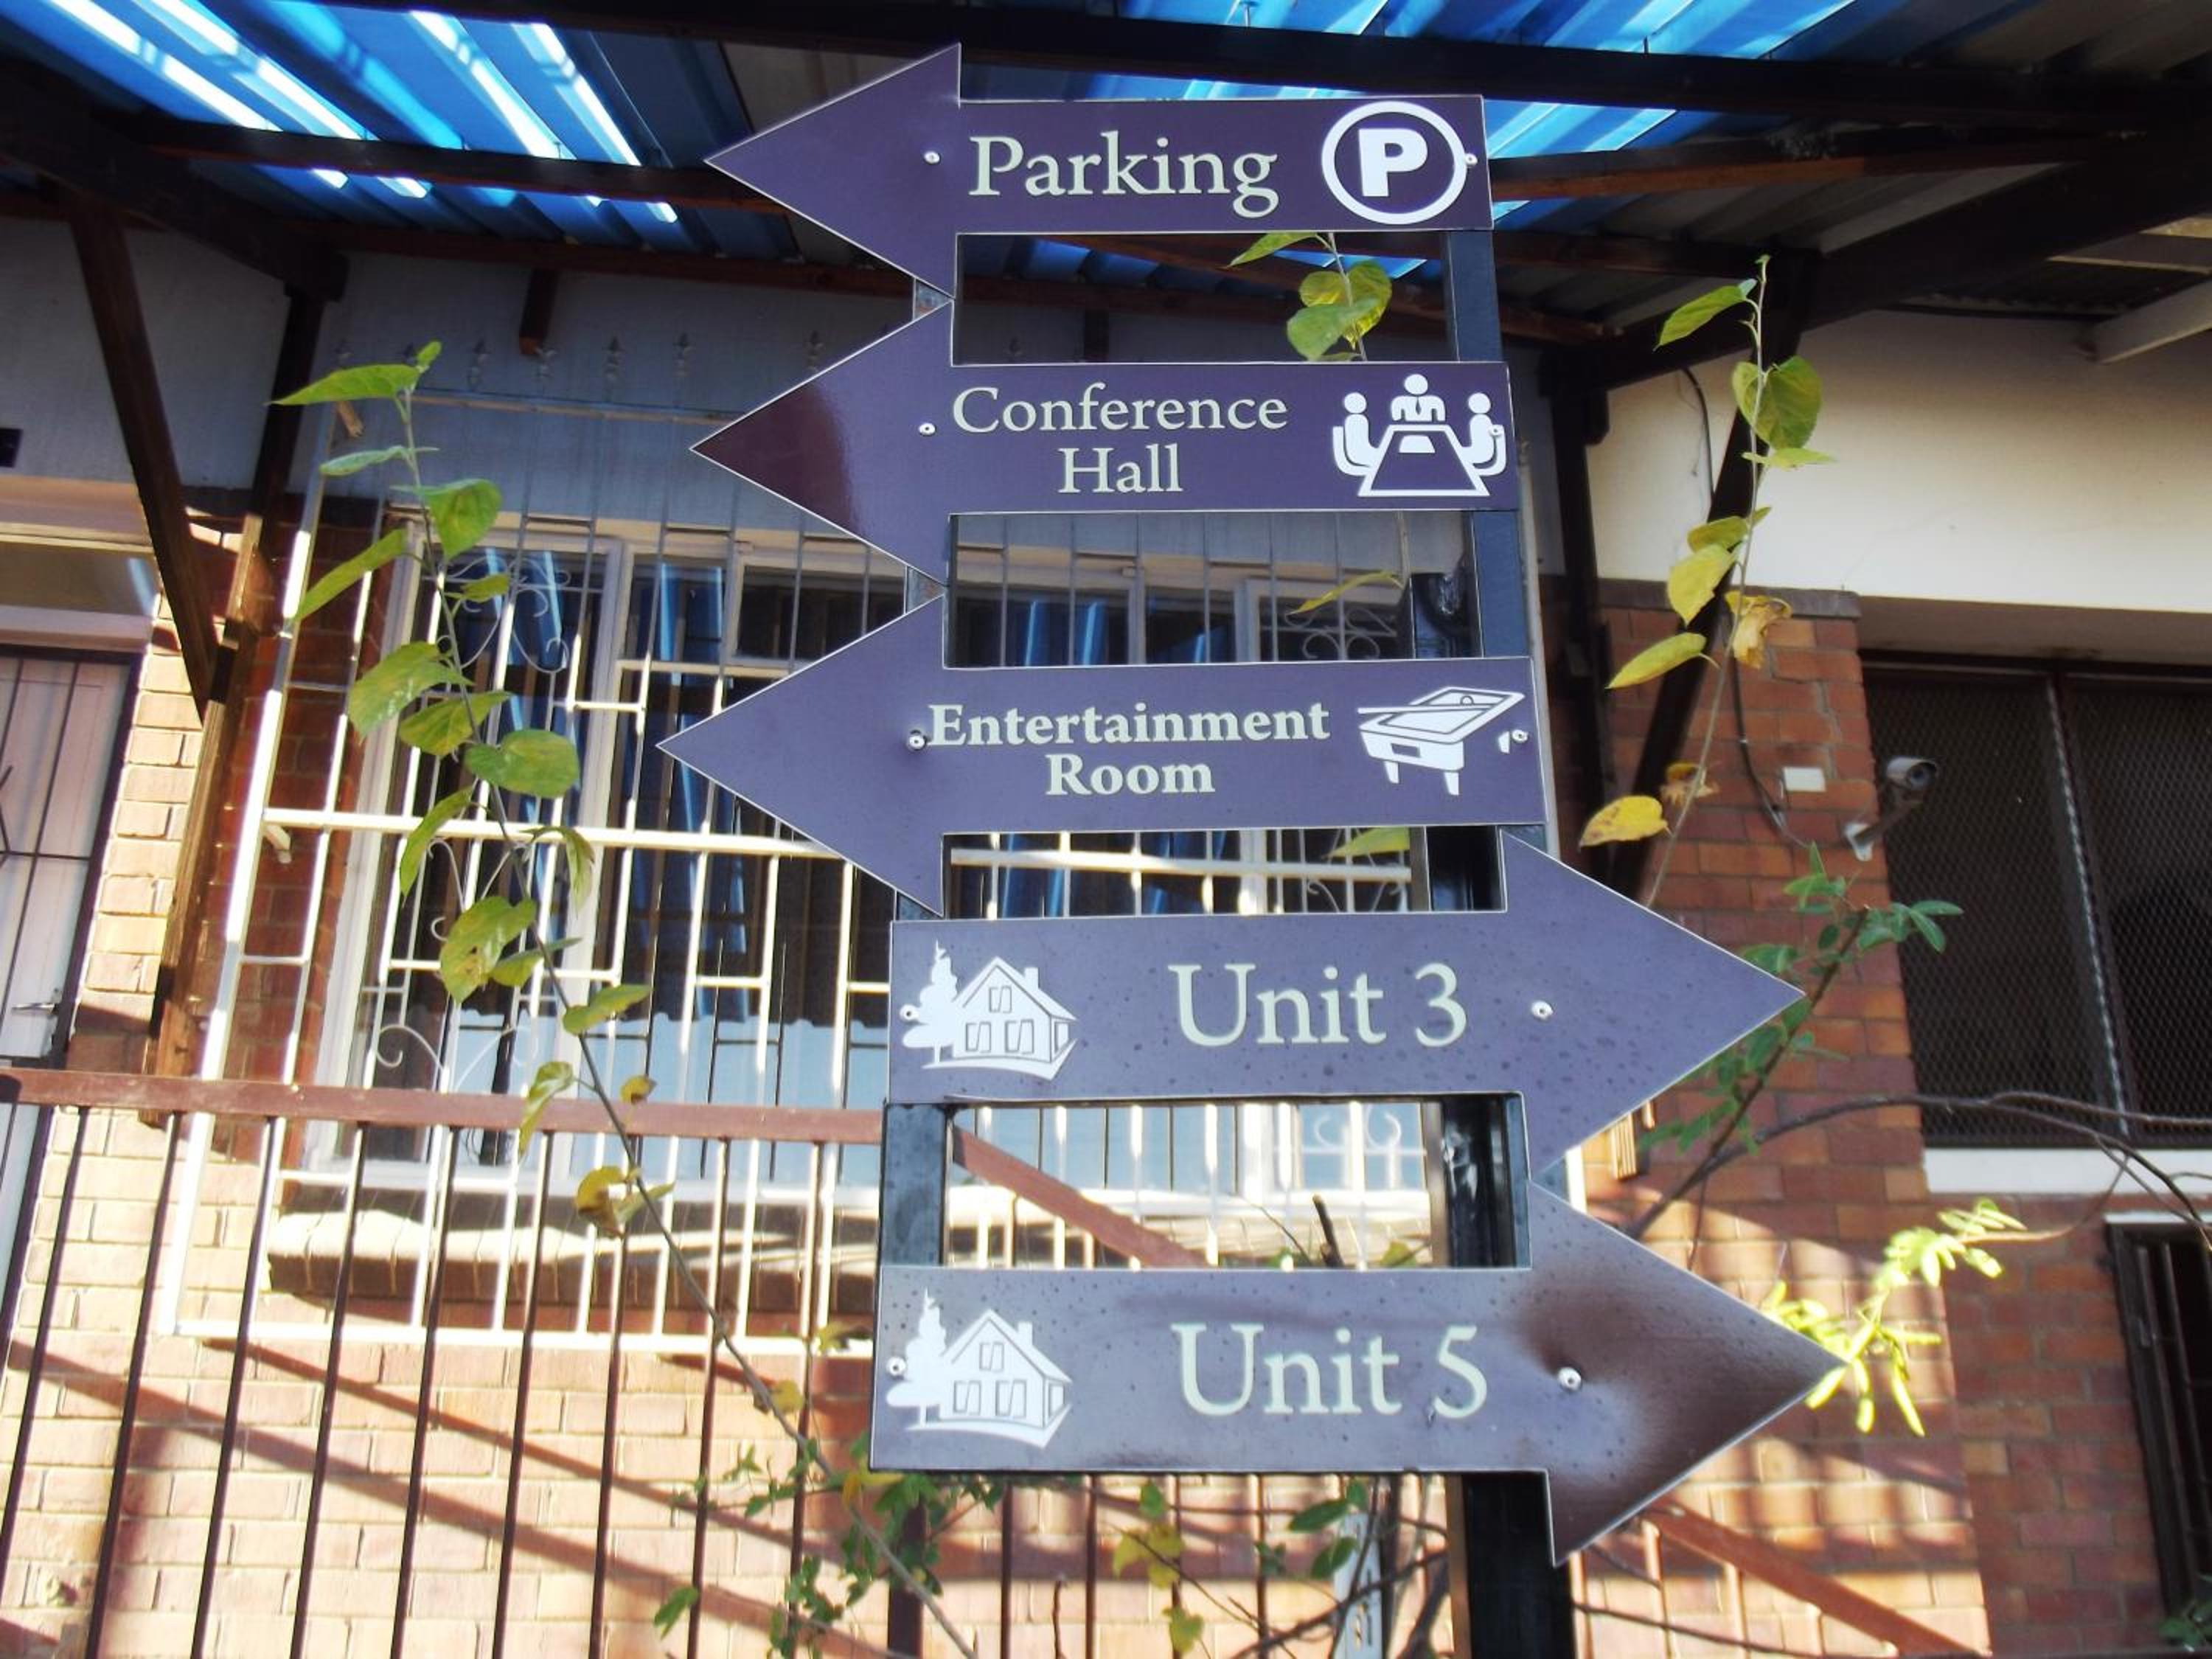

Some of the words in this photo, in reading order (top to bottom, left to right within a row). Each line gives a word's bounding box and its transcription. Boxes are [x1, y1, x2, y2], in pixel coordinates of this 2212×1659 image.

[970, 130, 1279, 218] Parking
[1359, 128, 1429, 196] P
[951, 382, 1289, 434] Conference
[1058, 442, 1183, 494] Hall
[928, 702, 1330, 746] Entertainment
[1045, 752, 1216, 796] Room
[1167, 964, 1387, 1047] Unit
[1414, 963, 1467, 1048] 3
[1171, 1324, 1402, 1417] Unit
[1433, 1326, 1488, 1419] 5
